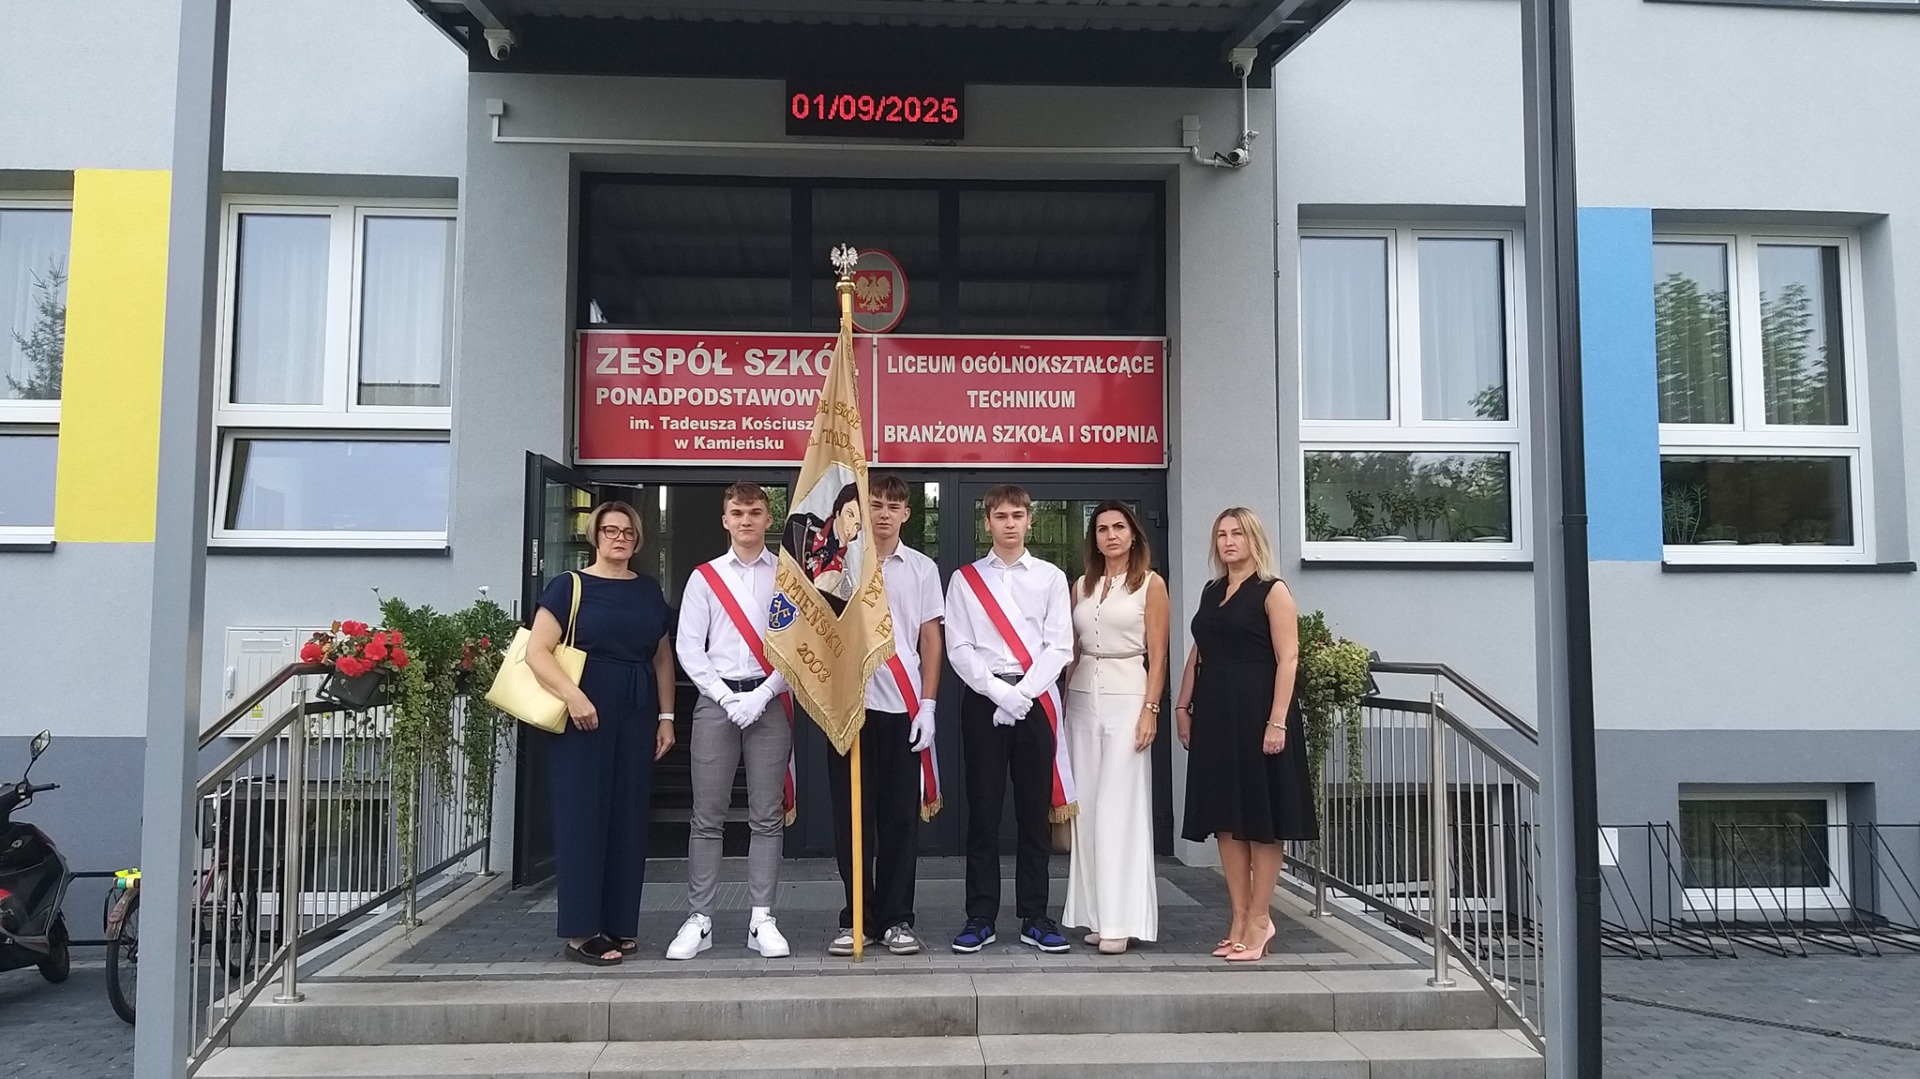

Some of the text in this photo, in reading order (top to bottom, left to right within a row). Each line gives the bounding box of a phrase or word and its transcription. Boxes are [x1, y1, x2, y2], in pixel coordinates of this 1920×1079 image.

[791, 93, 959, 124] 01/09/2025
[595, 341, 860, 377] ZESPÓŁ SZKÓ
[887, 352, 1154, 378] LICEUM OGÓLNOKSZTAŁCĄCE
[967, 390, 1076, 408] TECHNIKUM
[629, 416, 815, 431] im. Tadeusza Kościusz
[884, 421, 1159, 443] BRANŻOWA SZKOŁA I STOPNIA
[674, 435, 784, 450] w Kamieńsku
[776, 568, 846, 659] AMIEŃSKU
[796, 642, 832, 683] 2003
